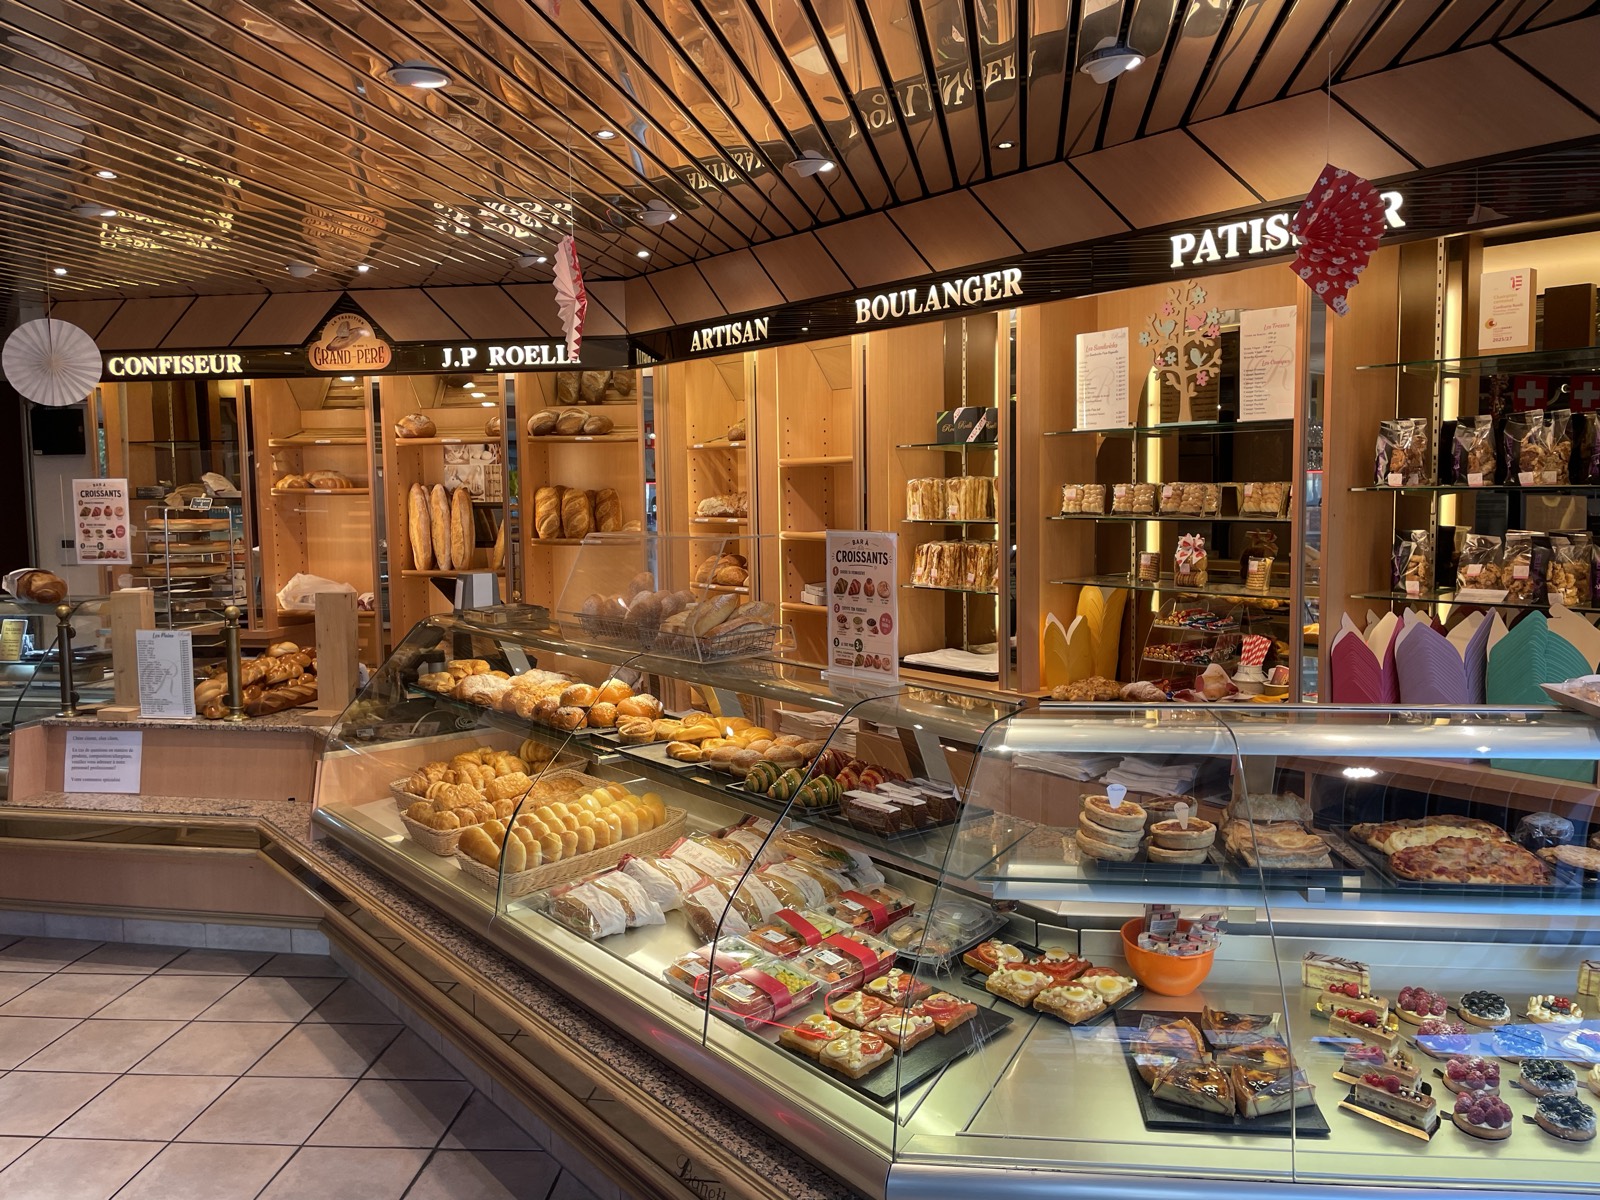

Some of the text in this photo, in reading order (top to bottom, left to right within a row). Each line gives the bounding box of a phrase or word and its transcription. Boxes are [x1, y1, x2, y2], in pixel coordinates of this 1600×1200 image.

[1170, 190, 1406, 268] PATISR
[855, 267, 1023, 324] BOULANGER
[690, 316, 770, 352] ARTISAN
[108, 354, 243, 376] CONFISEUR
[441, 348, 478, 368] J.P
[836, 550, 888, 565] CROISSANTS
